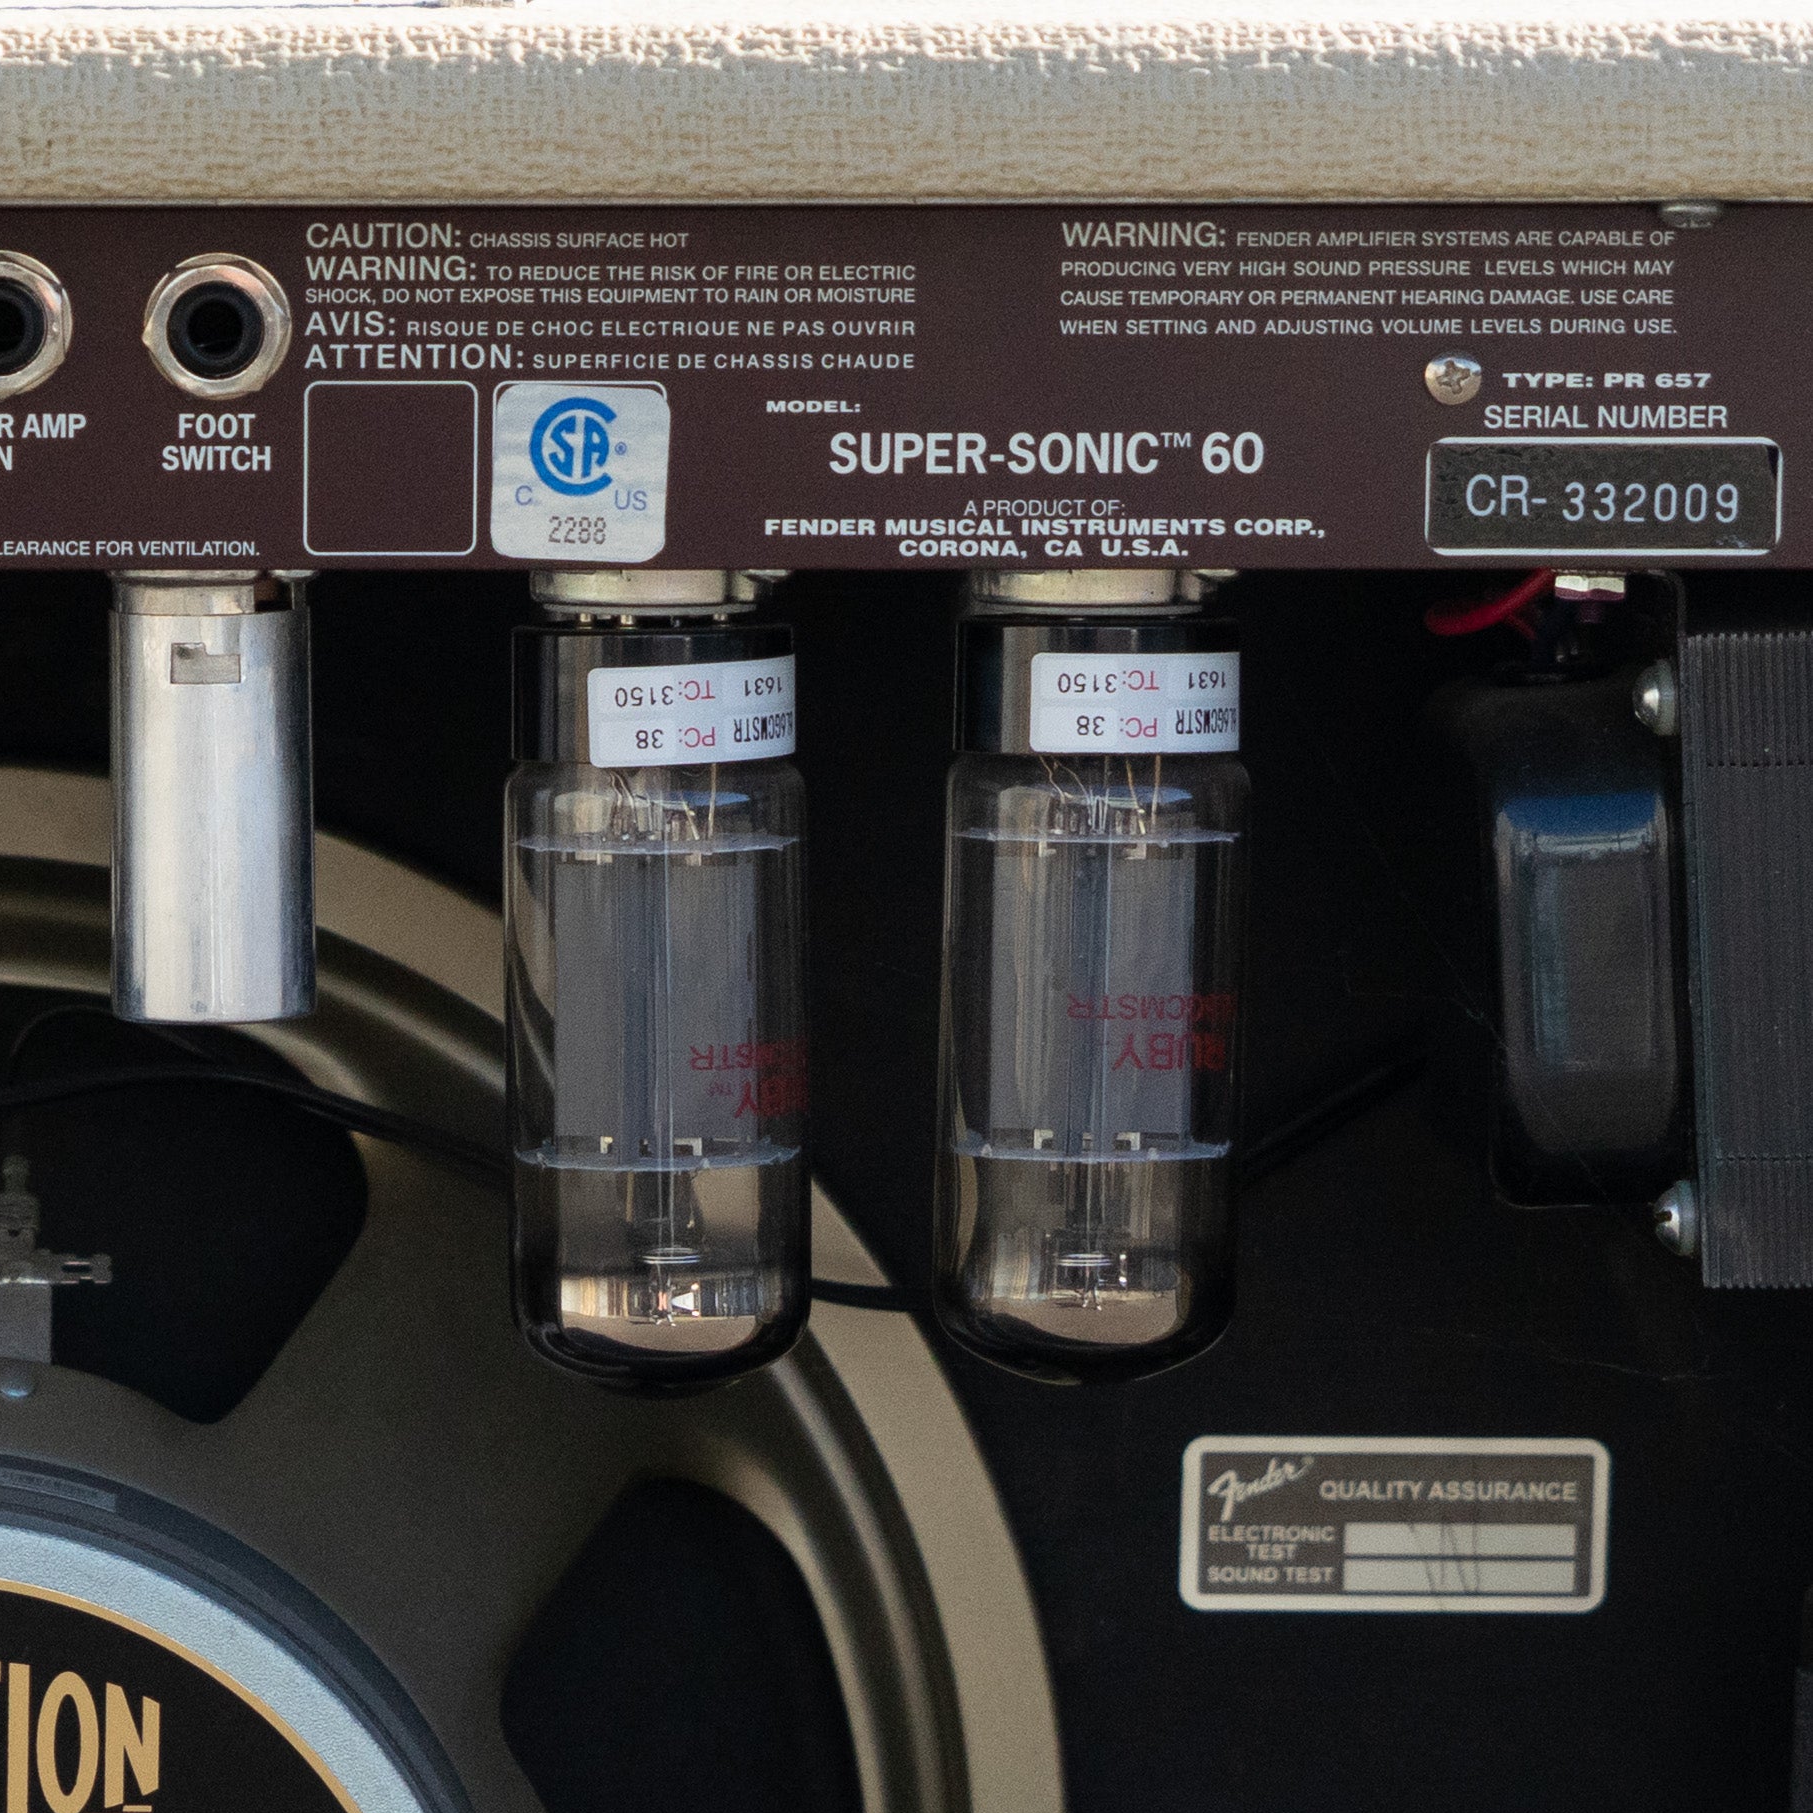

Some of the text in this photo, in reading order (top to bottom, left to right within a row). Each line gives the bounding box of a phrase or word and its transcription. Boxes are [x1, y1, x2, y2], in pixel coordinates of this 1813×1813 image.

[305, 222, 689, 249] CAUTION: CHASSIS SURFACE HOT
[1061, 220, 1675, 248] WARNING: FENDER AMPLIFIER SYSTEMS ARE CAPABLE OF
[305, 254, 916, 282] WARNING: TO REDUCE THE RISK OF FIRE OR ELECTRIC
[1059, 317, 1677, 336] WHEN SETTING AND ADJUSTING VOLUME LEVELS DURING USE.
[304, 342, 914, 370] ATTENTION: SUPERFICIE DE CHASSIS CHAUDE
[1502, 372, 1712, 389] TYPE: PR 657
[766, 399, 861, 414] MODEL:
[1483, 404, 1728, 430] SERIAL NUMBER
[21, 413, 87, 439] AMP
[178, 412, 256, 440] FOOT
[161, 445, 272, 472] SWITCH
[1201, 431, 1265, 475] 60
[614, 489, 648, 512] US
[963, 498, 1125, 518] A PRODUCT OF:
[1465, 473, 1739, 524] CR- 332009
[548, 515, 607, 546] 2288
[764, 518, 1325, 539] FENDER MUSICAL INSTRUMENTS CORP.,
[95, 540, 134, 557] FOR
[138, 540, 260, 557] VENTILATION.
[898, 538, 1189, 559] CORONA, CA U.S.A.
[615, 676, 783, 707] 1631 TC: 3150
[1057, 670, 1226, 694] 1631 TC: 3150
[1077, 715, 1105, 736] 38
[1119, 717, 1158, 738] PC:
[635, 729, 664, 749] 38
[679, 727, 715, 748] PC:
[1319, 1480, 1577, 1502] QUALITY ASSURANCE
[1207, 1524, 1335, 1542] ELECTRONIC
[1246, 1542, 1298, 1561] TEST
[1207, 1565, 1334, 1584] SOUND TEST
